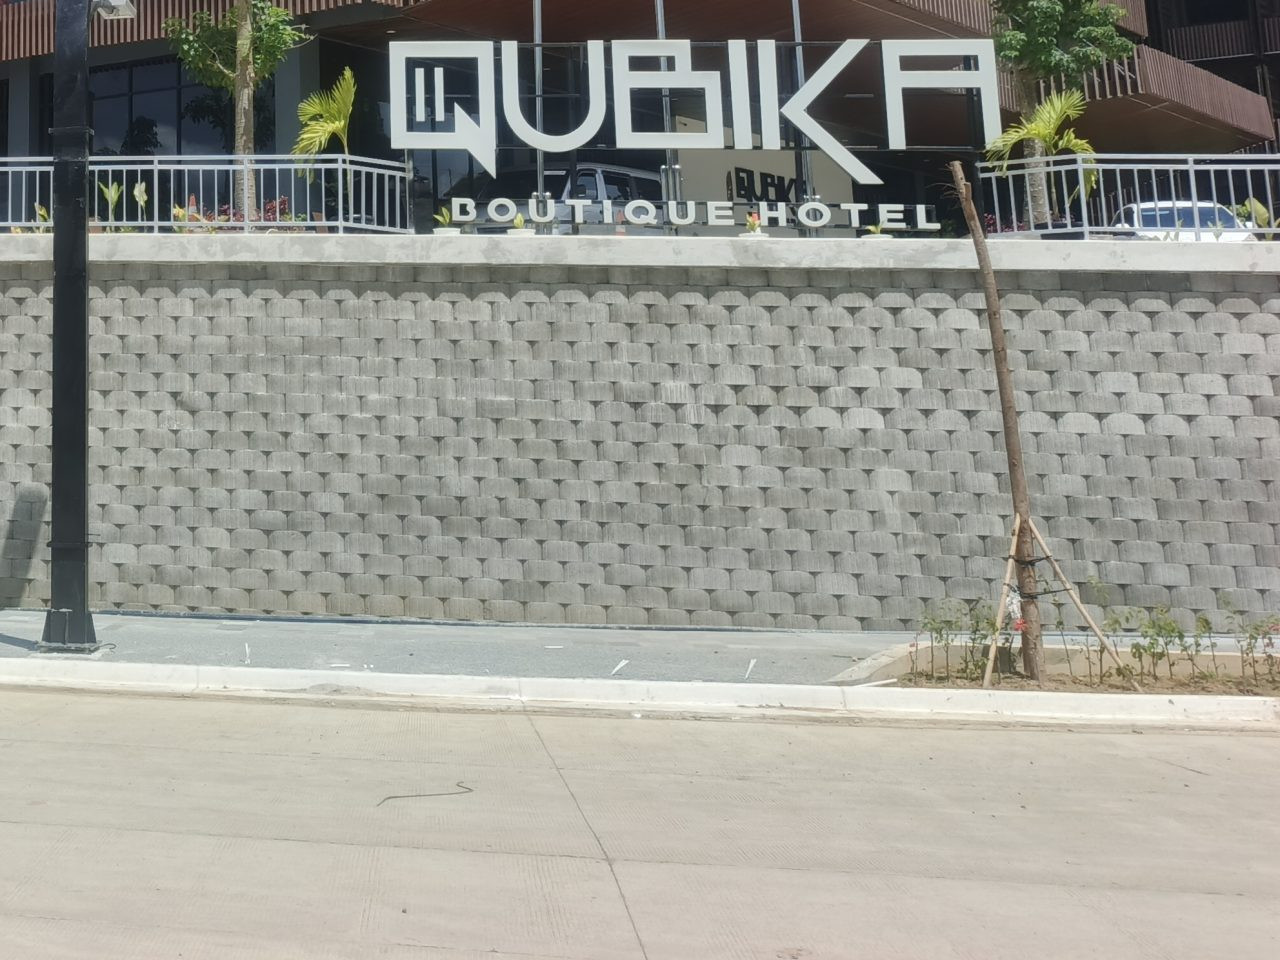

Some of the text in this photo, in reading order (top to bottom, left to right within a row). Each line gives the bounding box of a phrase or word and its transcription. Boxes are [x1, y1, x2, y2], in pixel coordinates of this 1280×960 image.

[389, 38, 1003, 185] QUBIKA
[451, 197, 942, 230] BOUTIQUE HOTEL
